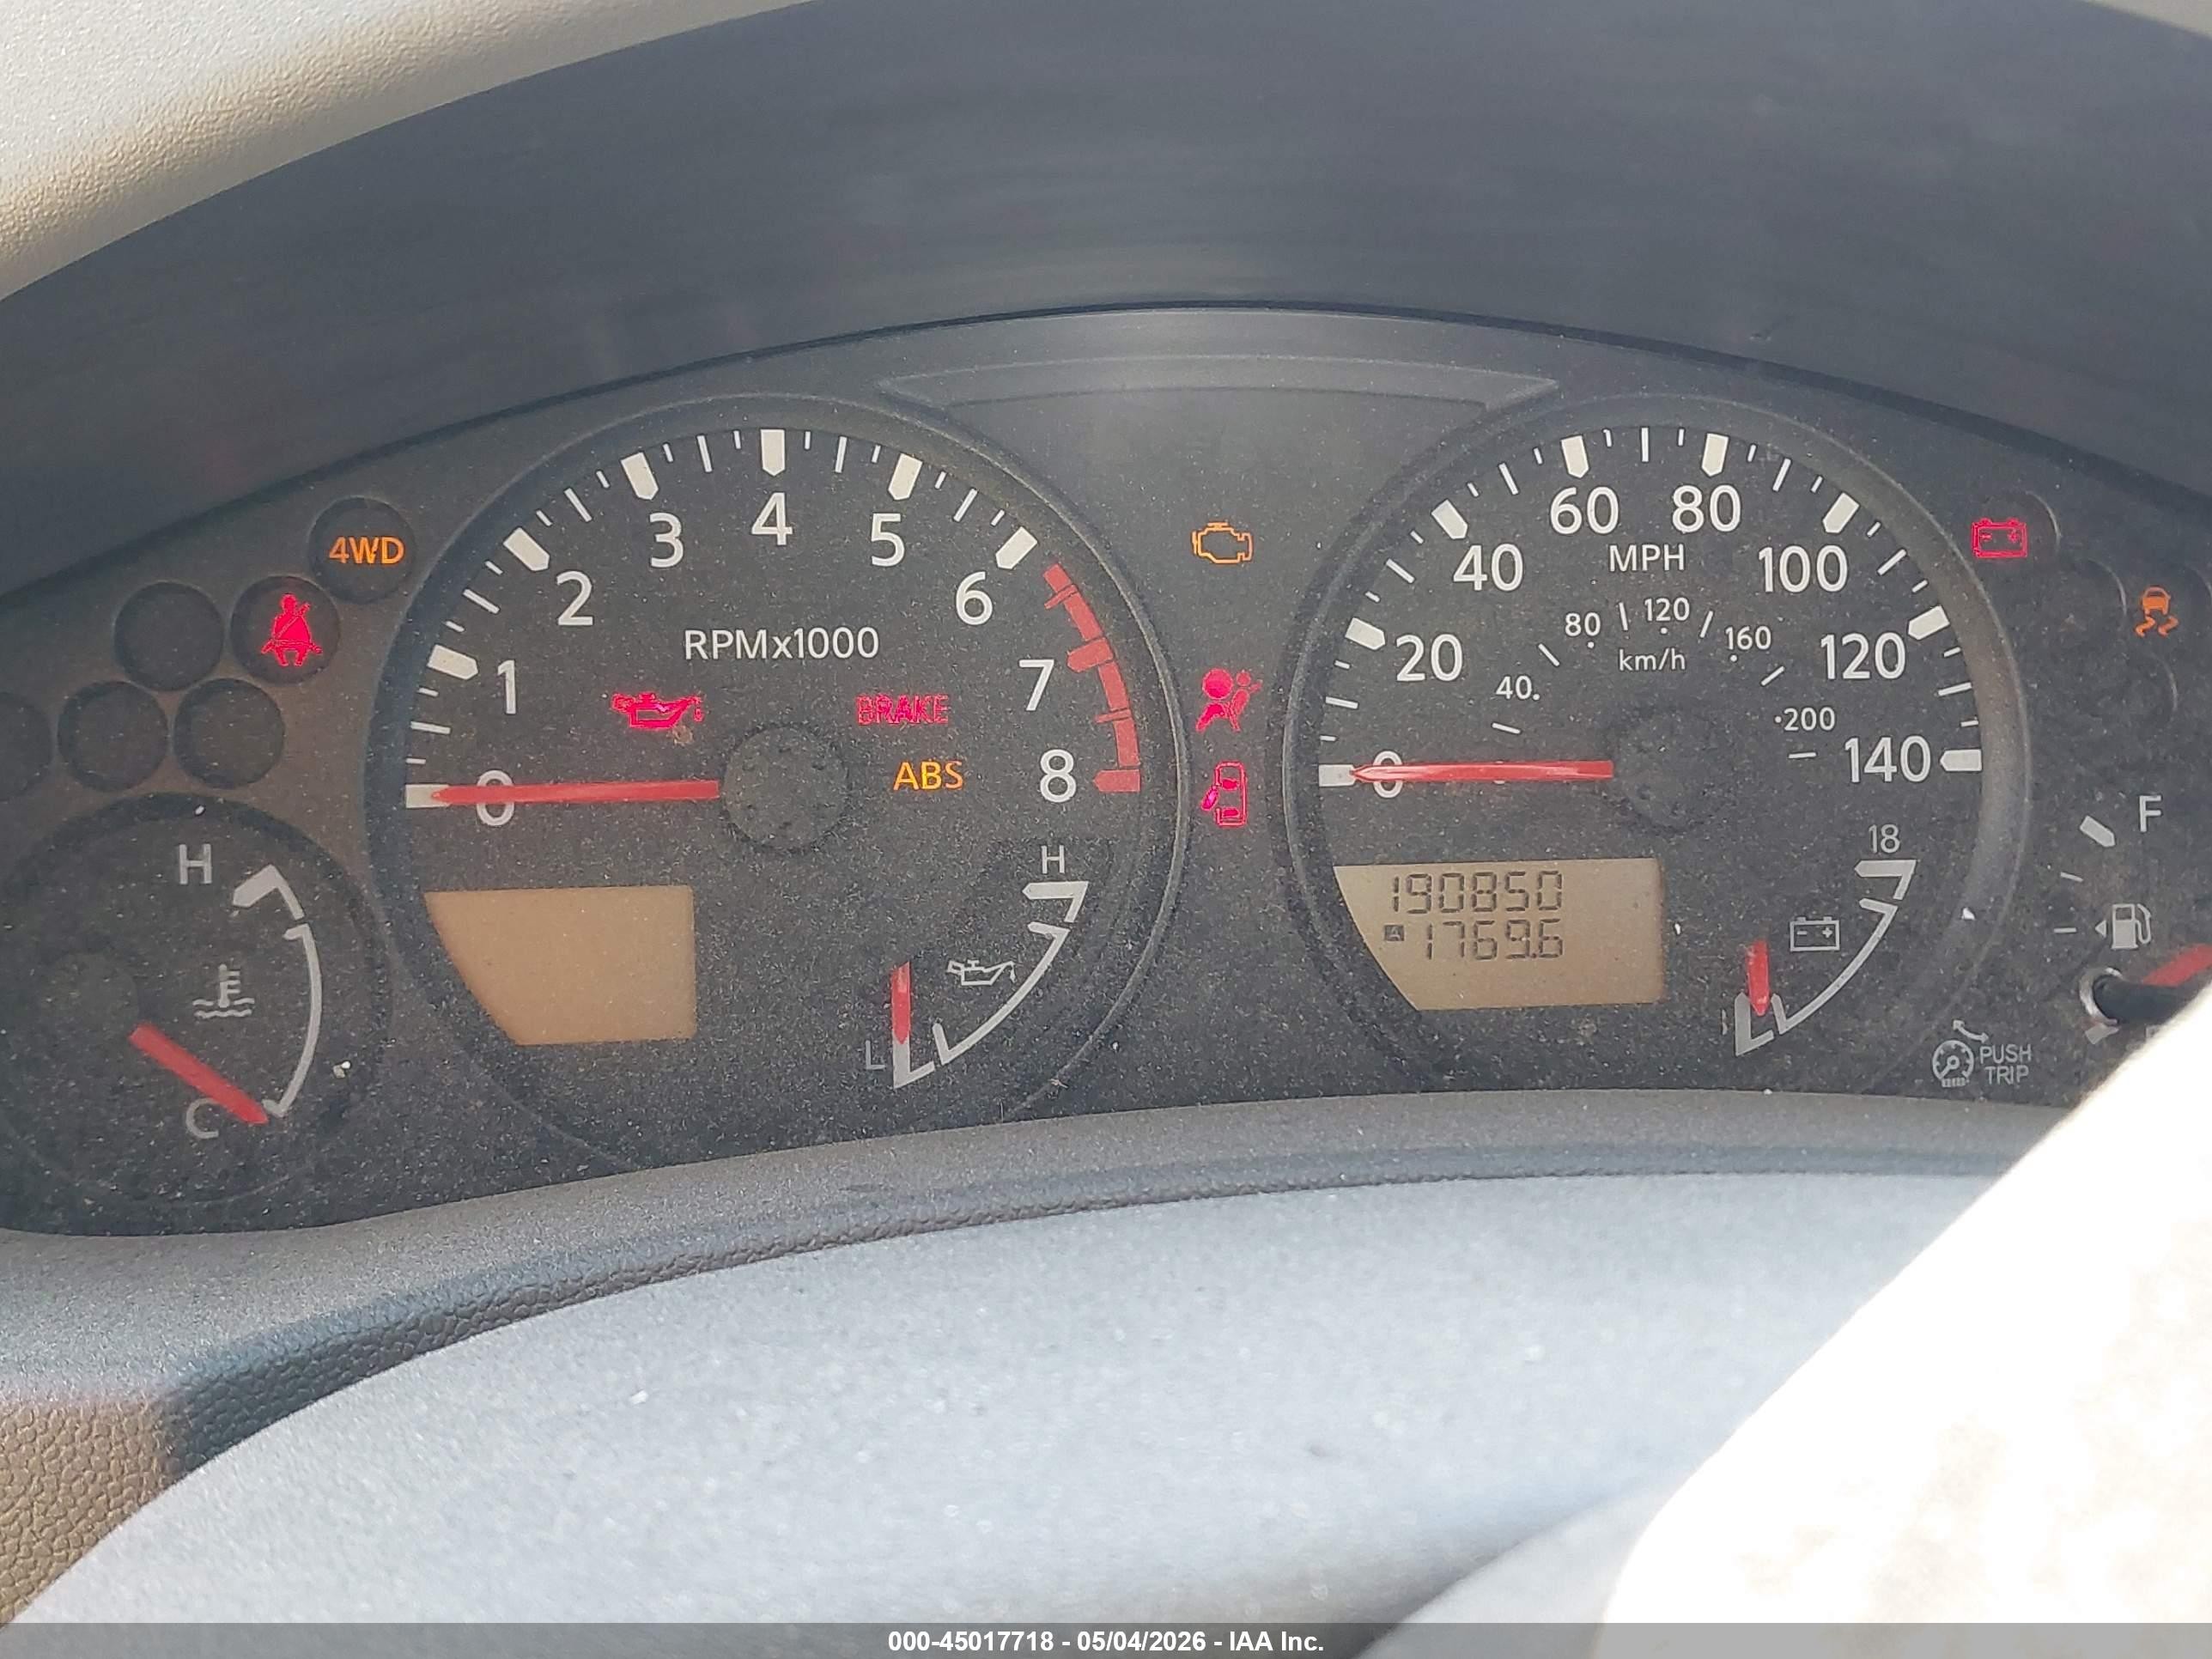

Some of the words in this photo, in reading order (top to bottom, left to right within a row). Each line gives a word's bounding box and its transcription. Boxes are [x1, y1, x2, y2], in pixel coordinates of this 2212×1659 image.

[751, 494, 793, 546] 4
[1549, 487, 1620, 534] 60
[1671, 485, 1741, 532] 80
[330, 537, 404, 564] 4WD
[650, 513, 684, 568] 3
[870, 514, 905, 567] 5
[1608, 544, 1685, 572] MPH
[1453, 544, 1524, 591] 40
[1758, 545, 1848, 592] 100
[557, 572, 594, 626] 2
[955, 572, 994, 625] 6
[1644, 599, 1690, 622] 120
[684, 627, 880, 659] RPMx1000
[1565, 612, 1601, 635] 80
[1724, 626, 1771, 651] 160
[1395, 634, 1463, 682] 20
[1619, 649, 1686, 672] km/h
[1820, 633, 1906, 679] 120
[498, 661, 517, 714] 1
[1018, 659, 1055, 712] 7
[857, 696, 949, 725] BRAKE
[1784, 708, 1836, 731] 200
[893, 762, 964, 791] ABS
[1039, 750, 1077, 803] 8
[1844, 736, 1931, 783] 140
[2139, 795, 2161, 832] F
[1868, 824, 1900, 853] 18
[179, 845, 212, 885] H
[1042, 846, 1065, 872] H
[1392, 870, 1563, 915] 190850
[1426, 919, 1563, 961] 1769.6
[866, 1041, 886, 1070] L
[1979, 1045, 2032, 1065] PUSH
[1985, 1065, 2029, 1085] TRIP
[186, 1099, 220, 1139] C
